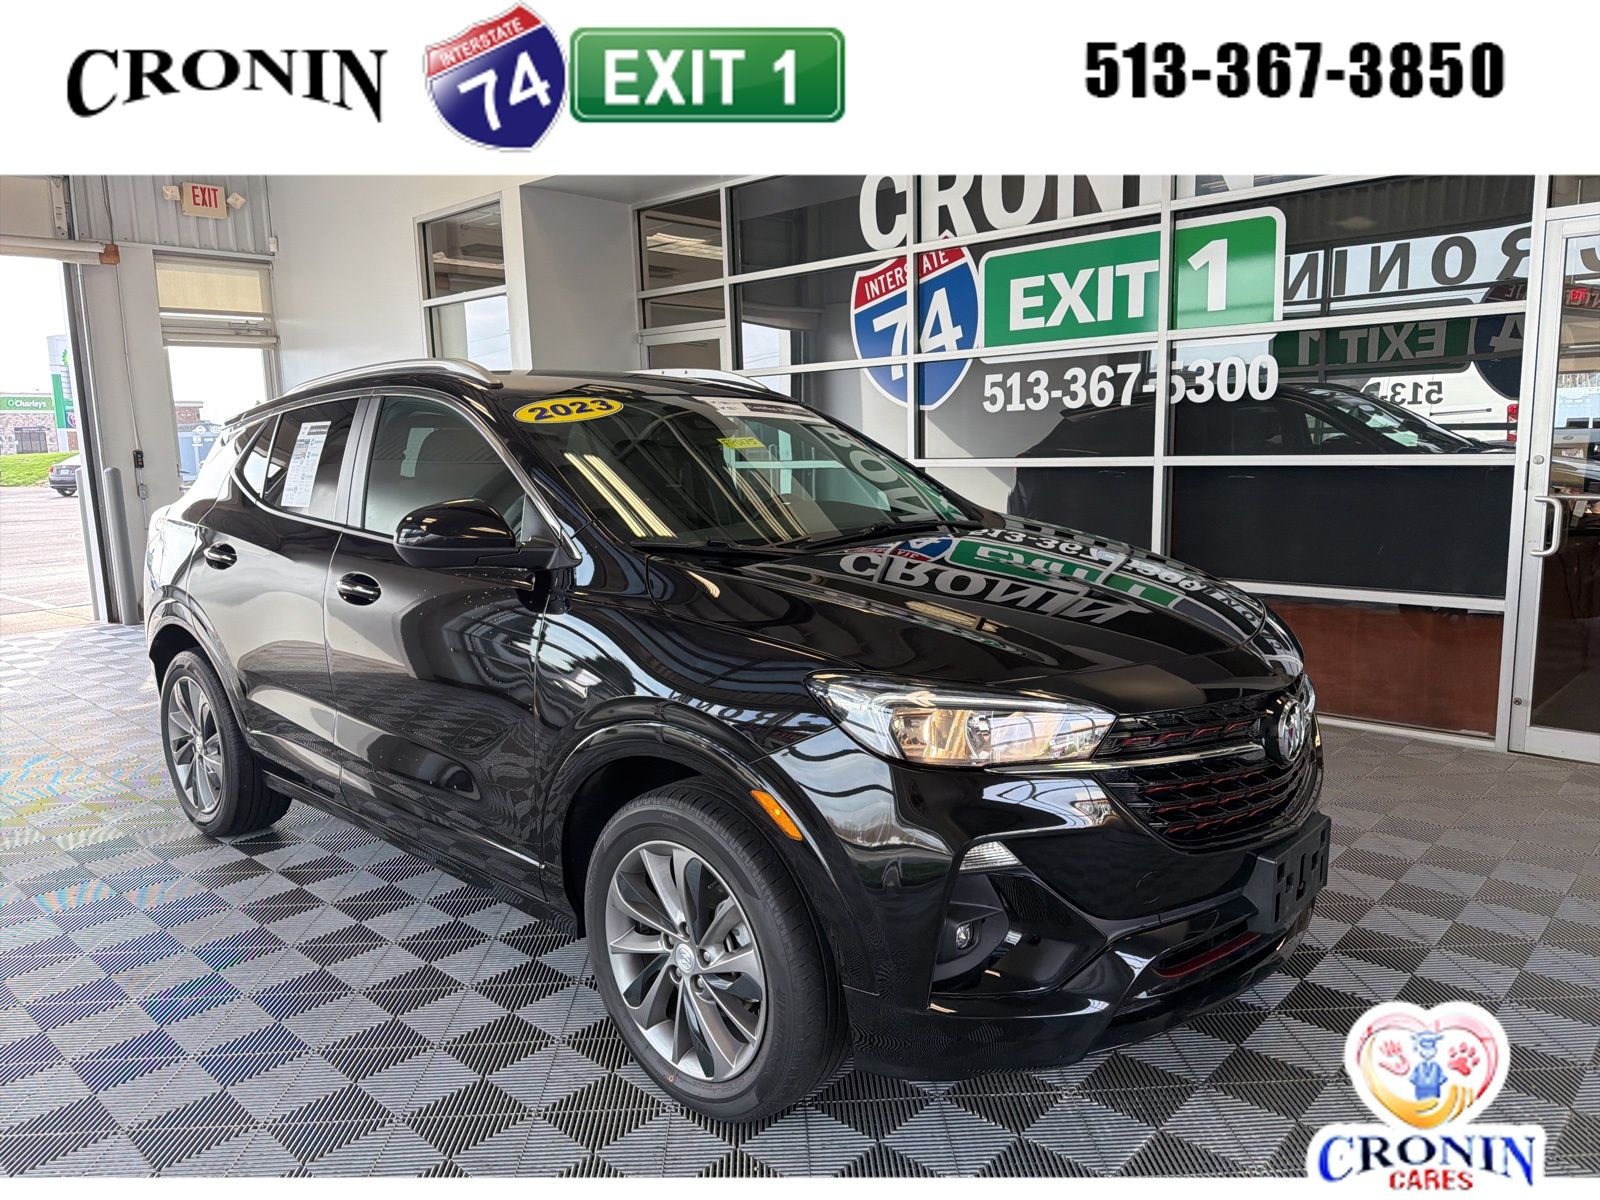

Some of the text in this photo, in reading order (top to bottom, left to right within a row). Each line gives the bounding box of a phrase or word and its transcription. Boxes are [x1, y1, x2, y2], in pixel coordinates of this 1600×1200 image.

[191, 185, 219, 209] EXIT
[865, 251, 949, 301] INTERATE
[1009, 238, 1228, 331] EXIT 1
[872, 287, 963, 381] 74
[528, 399, 615, 421] 2023
[982, 354, 1279, 413] 513-367-5300
